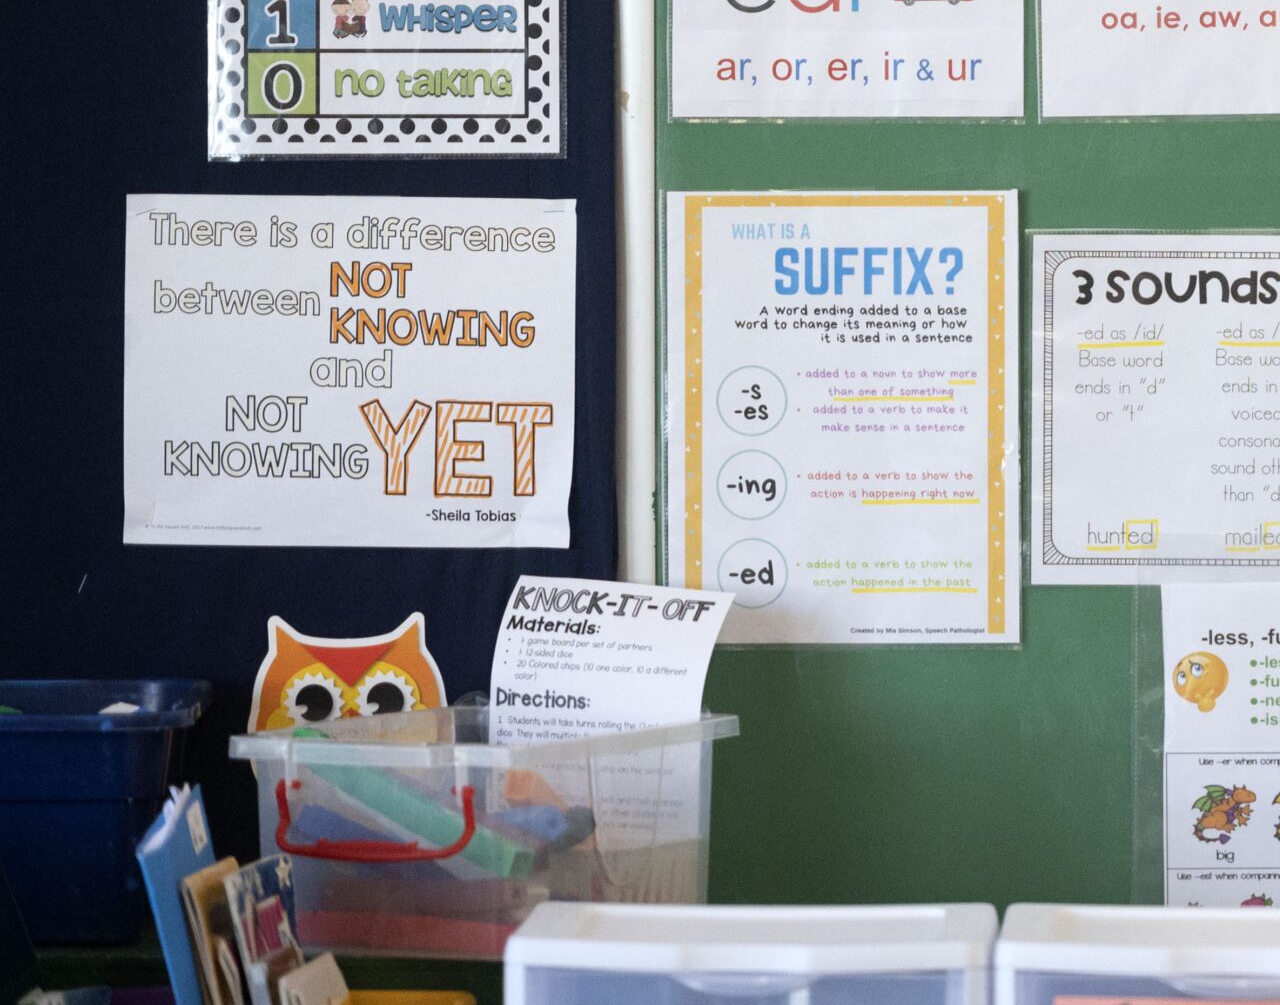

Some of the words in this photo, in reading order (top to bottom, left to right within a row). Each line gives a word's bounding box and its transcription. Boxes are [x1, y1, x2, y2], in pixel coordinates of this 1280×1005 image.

[1101, 12, 1145, 32] oa,
[1156, 6, 1188, 31] ie,
[1200, 9, 1248, 30] aw,
[717, 57, 757, 83] ar,
[772, 57, 812, 84] or,
[827, 57, 868, 84] er,
[884, 52, 904, 80] ir
[916, 59, 935, 80] &
[948, 57, 982, 80] ur
[263, 61, 303, 112] 0
[149, 213, 257, 247] There
[270, 215, 297, 248] is
[311, 225, 334, 249] a
[347, 216, 555, 252] difference
[731, 223, 775, 239] WHAT
[781, 223, 795, 239] IS
[801, 223, 810, 239] A
[331, 261, 412, 298] NOT
[775, 247, 964, 295] SUFFIX?
[153, 280, 320, 316] between
[1072, 270, 1094, 305] 3
[759, 306, 768, 316] A
[775, 306, 808, 316] word
[814, 305, 853, 317] ending
[860, 305, 899, 316] added
[905, 306, 918, 316] to
[937, 305, 967, 316] base
[330, 308, 535, 348] KNOWING
[310, 349, 392, 388] and
[226, 396, 308, 432] NOT
[734, 405, 769, 420] -es
[164, 441, 369, 478] KNOWING
[359, 399, 553, 498] YET
[726, 476, 777, 501] -ing
[426, 509, 471, 522] -Sheila
[475, 509, 516, 522] Tobias
[1087, 522, 1154, 546] hunted
[729, 560, 774, 585] -ed
[506, 616, 601, 635] Materials:
[1201, 630, 1254, 647] -less,
[496, 687, 590, 709] Directions:
[1216, 849, 1234, 863] big
